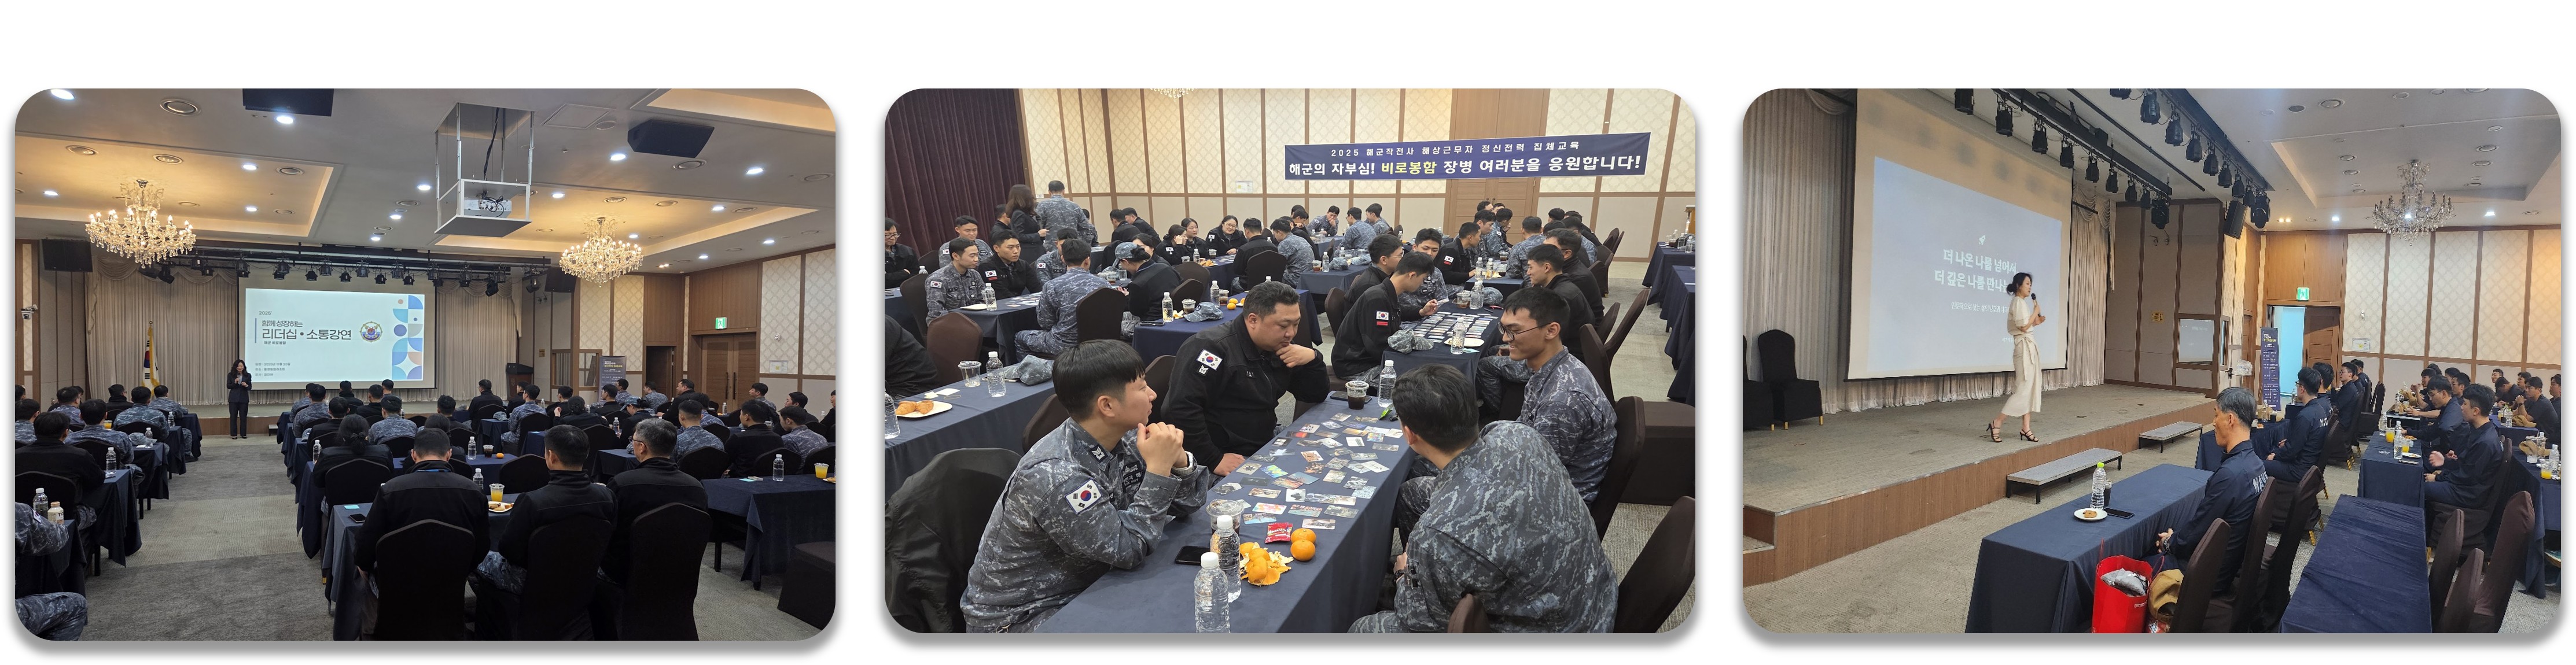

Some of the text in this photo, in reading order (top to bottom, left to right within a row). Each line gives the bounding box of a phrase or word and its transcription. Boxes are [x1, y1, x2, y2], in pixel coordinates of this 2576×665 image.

[1366, 148, 1414, 156] 해군작전사
[1422, 145, 1474, 155] 해상근무자
[1482, 143, 1525, 153] 정신전력
[1533, 141, 1580, 152] 집체교육
[1289, 155, 1641, 175] 해군의 자부심! 비로봉함 장병 여러분을 응원합니다!
[1943, 249, 1953, 264] 더
[1975, 255, 1993, 271] 나를
[1934, 269, 1945, 285] 더
[1947, 271, 1966, 288] 깊은
[1968, 274, 1985, 290] 나를
[262, 328, 352, 340] 리더십 소통강연
